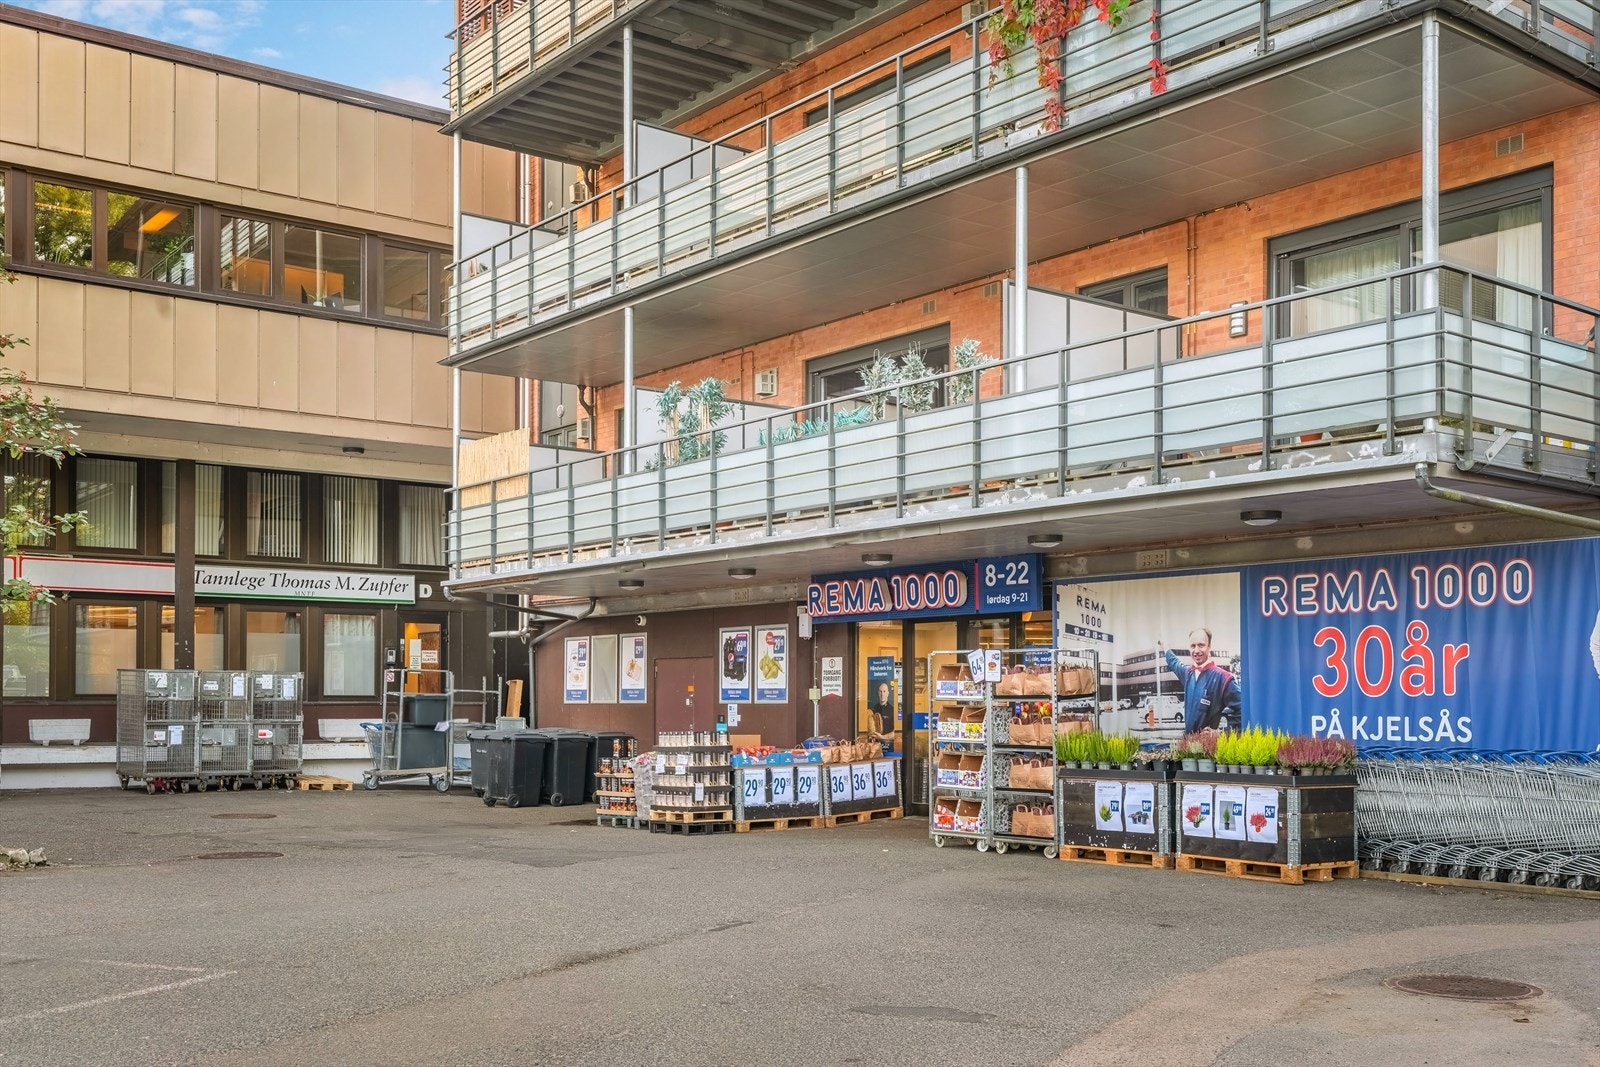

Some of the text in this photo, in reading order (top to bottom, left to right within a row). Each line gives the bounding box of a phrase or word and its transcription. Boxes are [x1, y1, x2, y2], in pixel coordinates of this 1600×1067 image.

[194, 569, 409, 596] Tannlege Thomas M. Zupfer
[985, 561, 1029, 587] 8-22
[419, 583, 433, 599] D
[807, 570, 962, 616] REMA 1000
[1261, 558, 1534, 617] REMA 1000
[986, 592, 1029, 605] lørdag 9-21
[1076, 595, 1106, 614] REMA
[1081, 613, 1102, 628] 1000
[971, 658, 982, 676] 64
[1312, 619, 1470, 697] 30år
[1311, 708, 1473, 743] PÅ KJELSÅS
[745, 779, 758, 797] 29
[774, 777, 786, 795] 29
[799, 776, 811, 793] 29
[832, 776, 844, 793] 36
[853, 773, 866, 791] 36
[876, 771, 888, 788] 36
